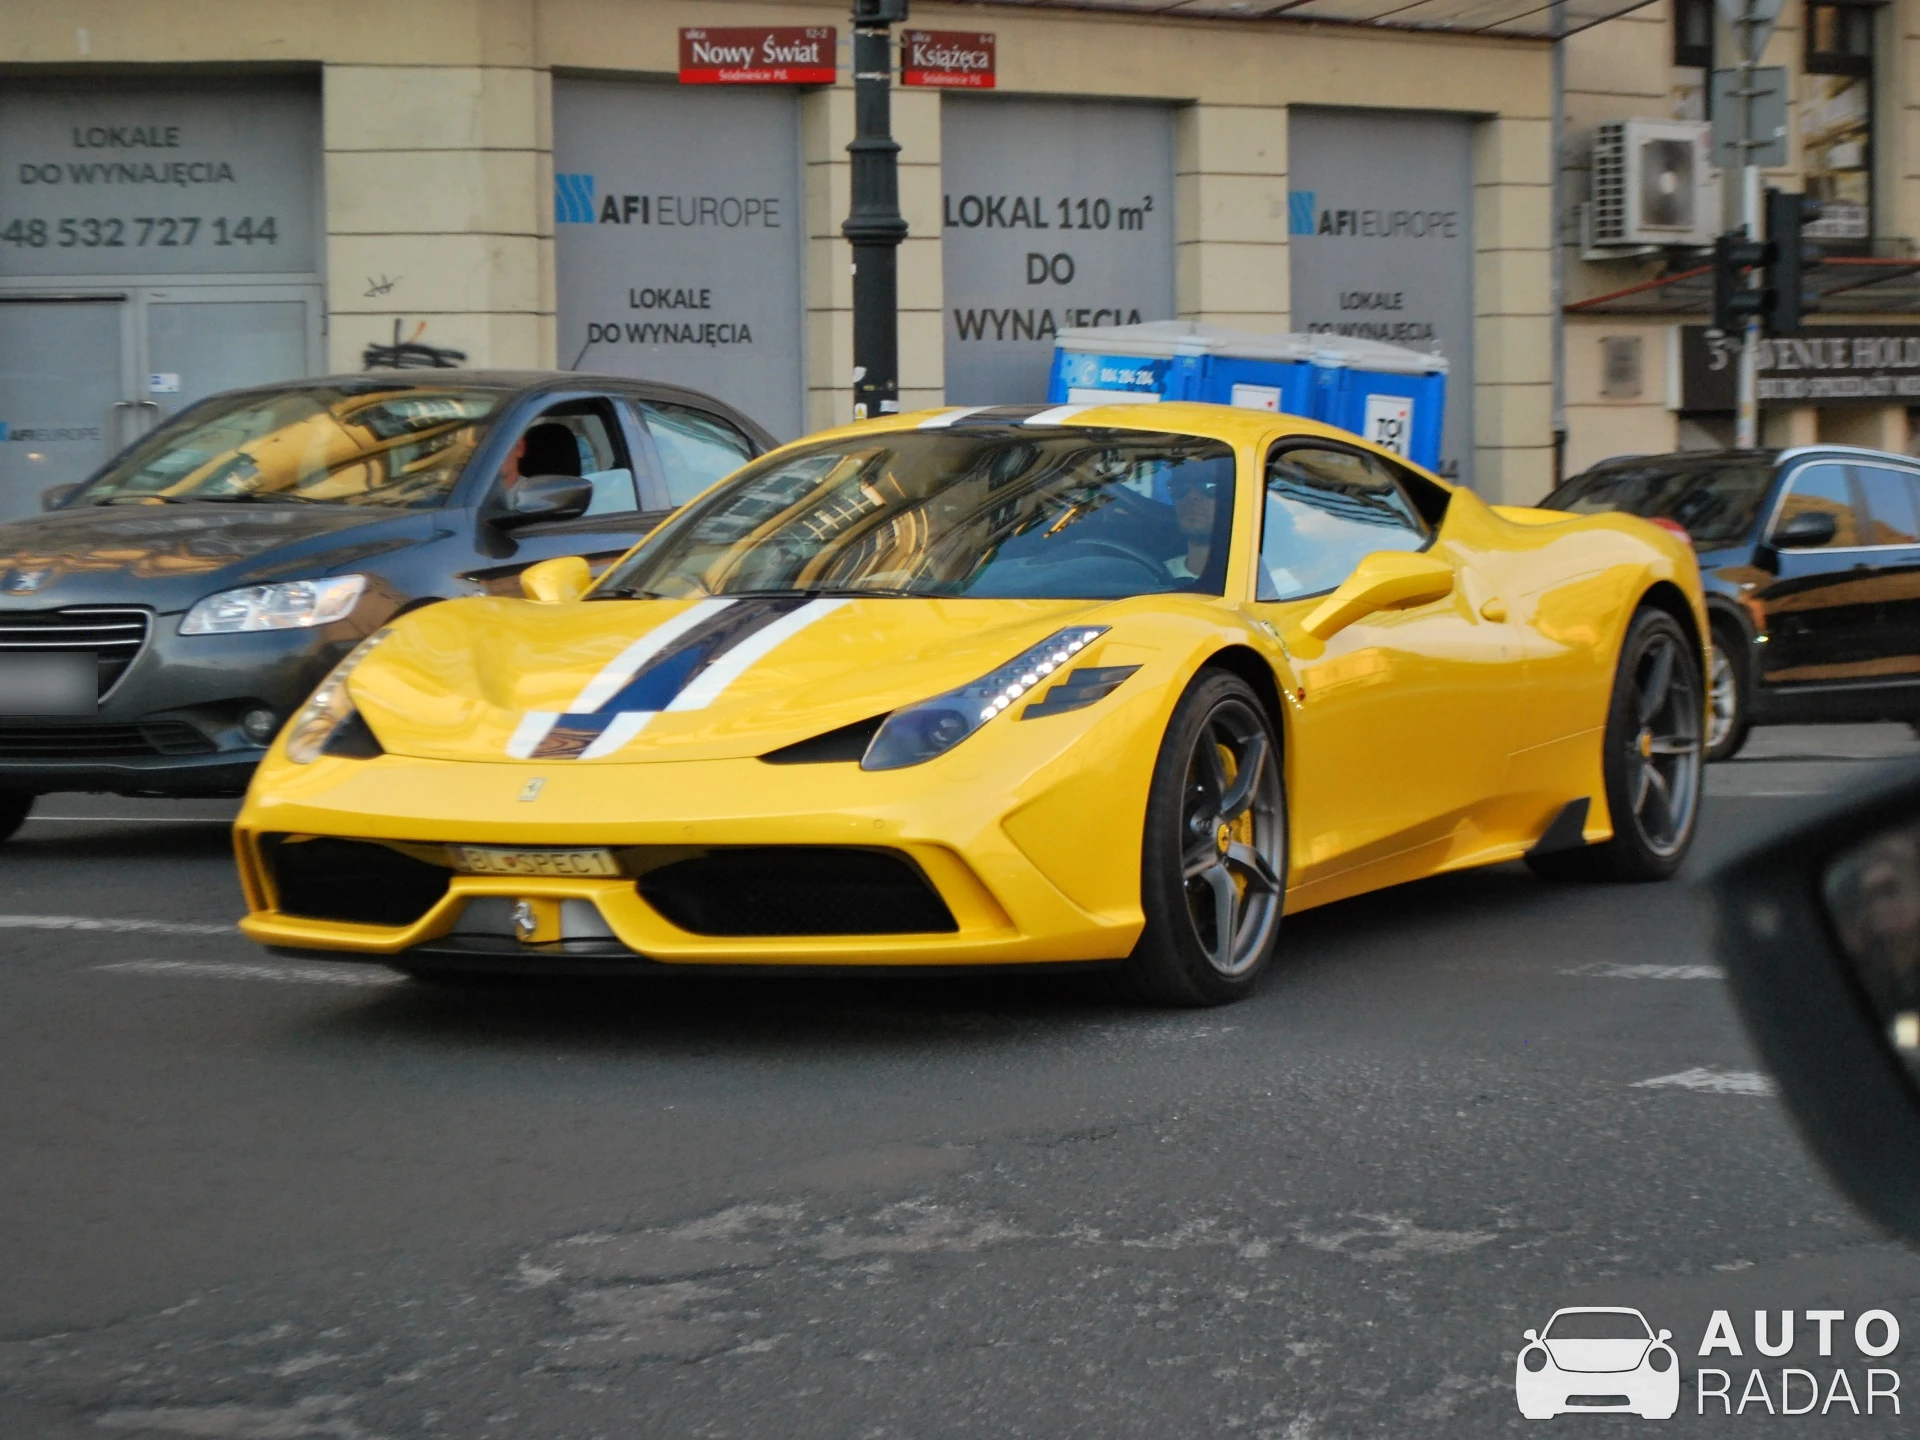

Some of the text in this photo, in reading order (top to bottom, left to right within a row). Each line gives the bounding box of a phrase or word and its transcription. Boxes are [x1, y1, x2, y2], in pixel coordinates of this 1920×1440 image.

[692, 34, 819, 70] Nowy Świat
[912, 44, 989, 72] Książęca
[73, 126, 180, 148] LOKALE
[19, 162, 236, 187] DO WYNAJĘCIA
[600, 195, 780, 228] AFI EUROPE
[943, 195, 1049, 229] LOKAL
[1057, 197, 1111, 230] 110
[1316, 209, 1458, 238] AFI EUROPE
[0, 216, 278, 248] 48 532 727 144
[1026, 252, 1075, 285] DO
[630, 288, 711, 309] LOKALE
[1339, 292, 1403, 310] LOKALE
[587, 323, 752, 347] DO WYNAJĘCIA
